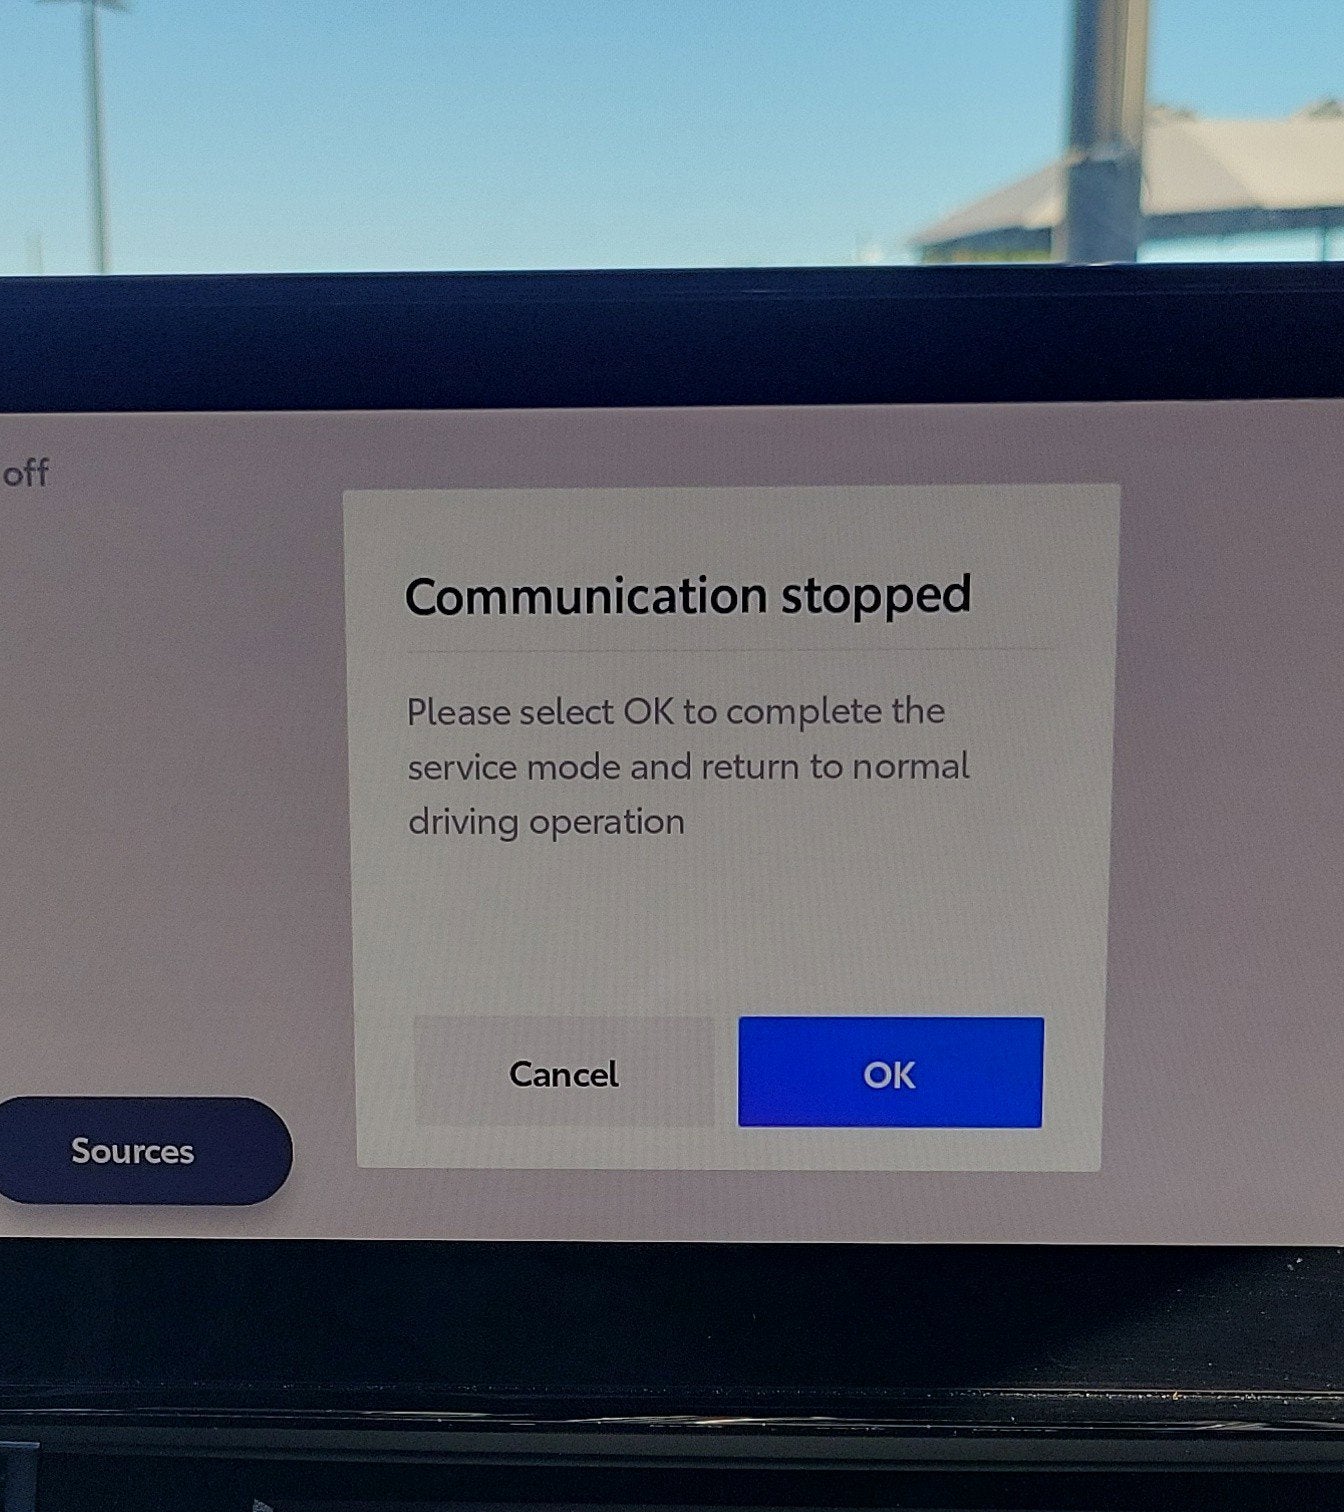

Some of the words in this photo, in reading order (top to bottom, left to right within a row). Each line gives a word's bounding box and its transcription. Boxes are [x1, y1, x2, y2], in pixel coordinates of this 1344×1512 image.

[2, 456, 51, 488] off
[404, 574, 769, 617] Communication
[780, 571, 973, 624] stopped
[407, 696, 512, 727] Please
[519, 695, 615, 726] select
[623, 696, 674, 726] OK
[683, 700, 718, 725] to
[726, 695, 883, 732] complete
[891, 694, 946, 725] the
[408, 753, 518, 781] service
[527, 752, 622, 781] mode
[630, 751, 692, 780] and
[701, 754, 799, 780] return
[810, 754, 844, 779] to
[853, 750, 972, 780] normal
[408, 806, 519, 843] driving
[528, 805, 685, 842] operation
[509, 1059, 619, 1088] Cancel
[863, 1060, 916, 1090] OK
[71, 1136, 196, 1165] Sources
